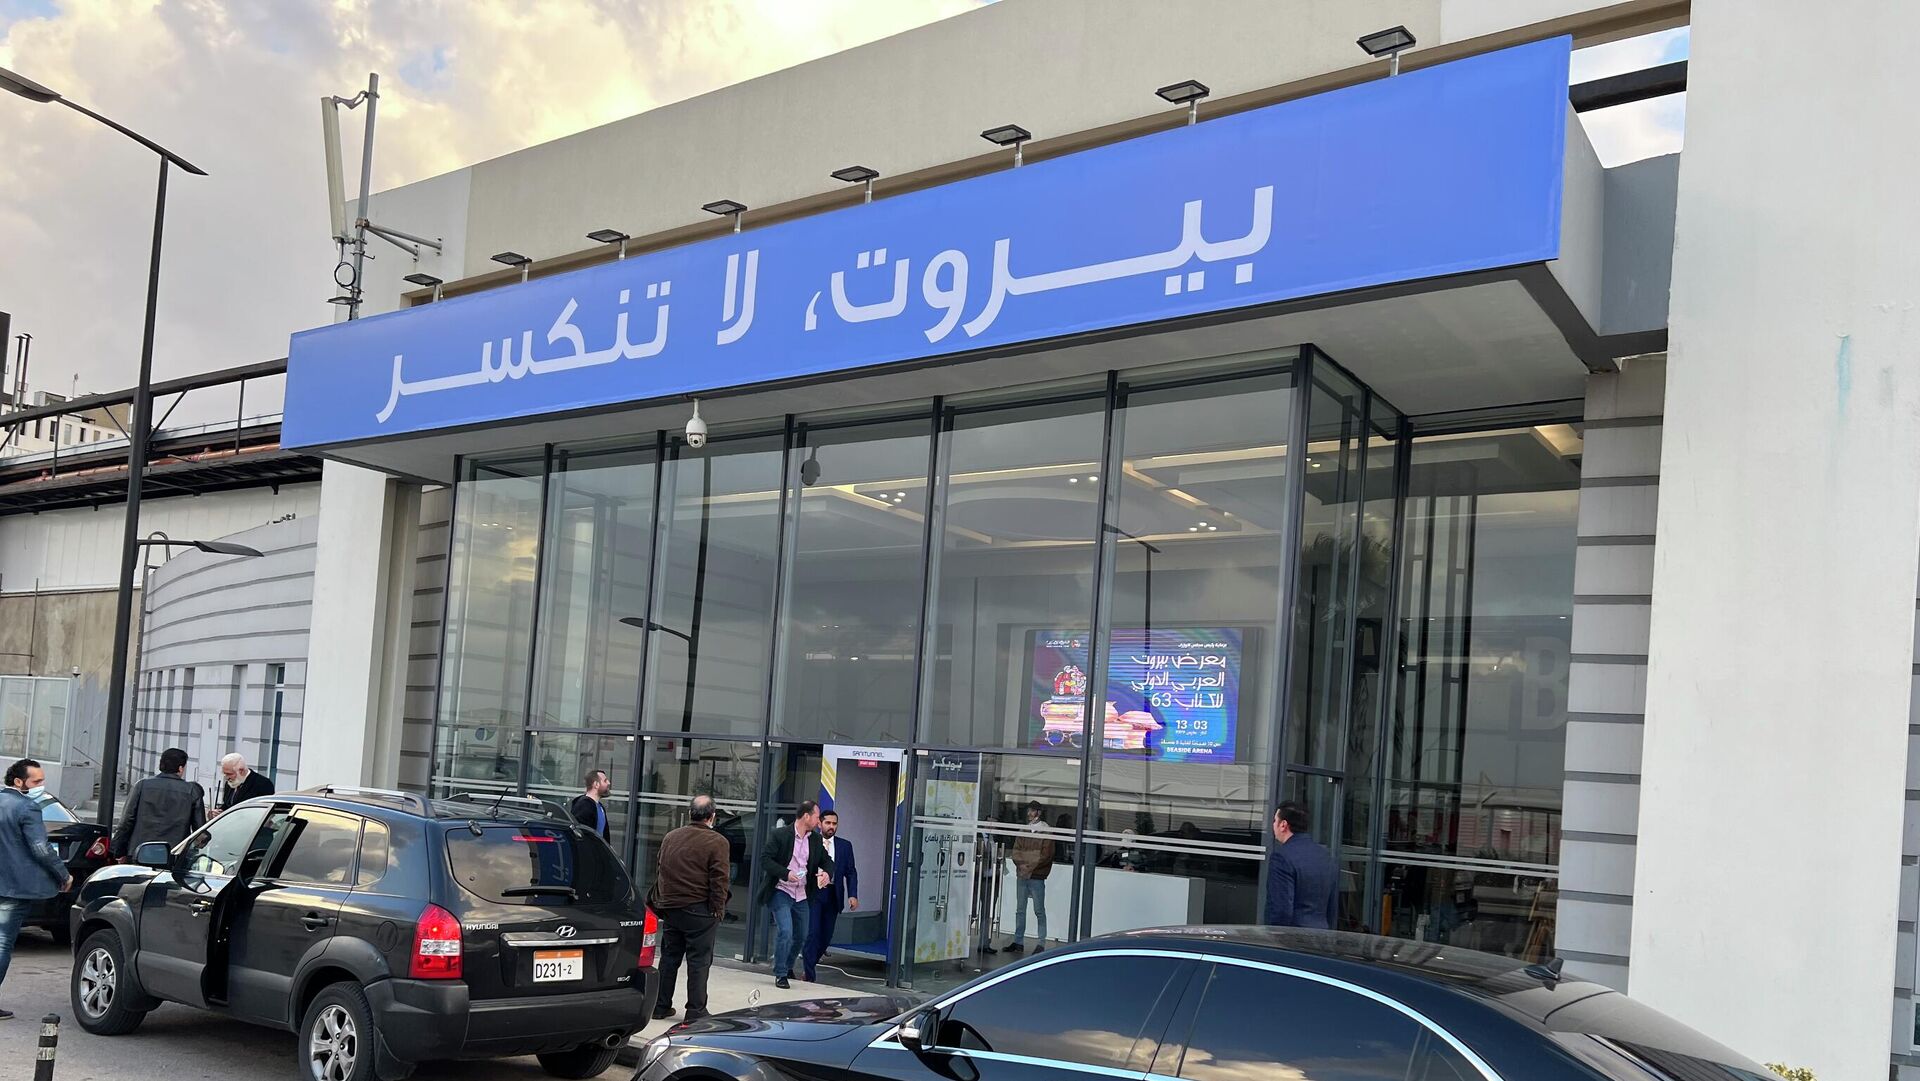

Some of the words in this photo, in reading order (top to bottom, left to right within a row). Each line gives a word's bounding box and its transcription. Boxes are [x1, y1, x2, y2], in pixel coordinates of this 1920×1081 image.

[718, 249, 759, 346] لا
[376, 280, 671, 424] تنكسر
[1131, 654, 1169, 670] بيروت
[1171, 652, 1226, 669] معرض
[1131, 671, 1169, 692] الدولي
[1171, 671, 1225, 692] العربي
[1151, 692, 1172, 707] 63
[1174, 693, 1224, 710] للكتاب
[1175, 719, 1188, 730] 13
[1193, 720, 1208, 730] 03
[1166, 746, 1192, 754] SEASIDE
[1192, 747, 1213, 755] ARENA
[465, 923, 499, 931] HYUNDAI
[535, 961, 573, 979] D231-2
